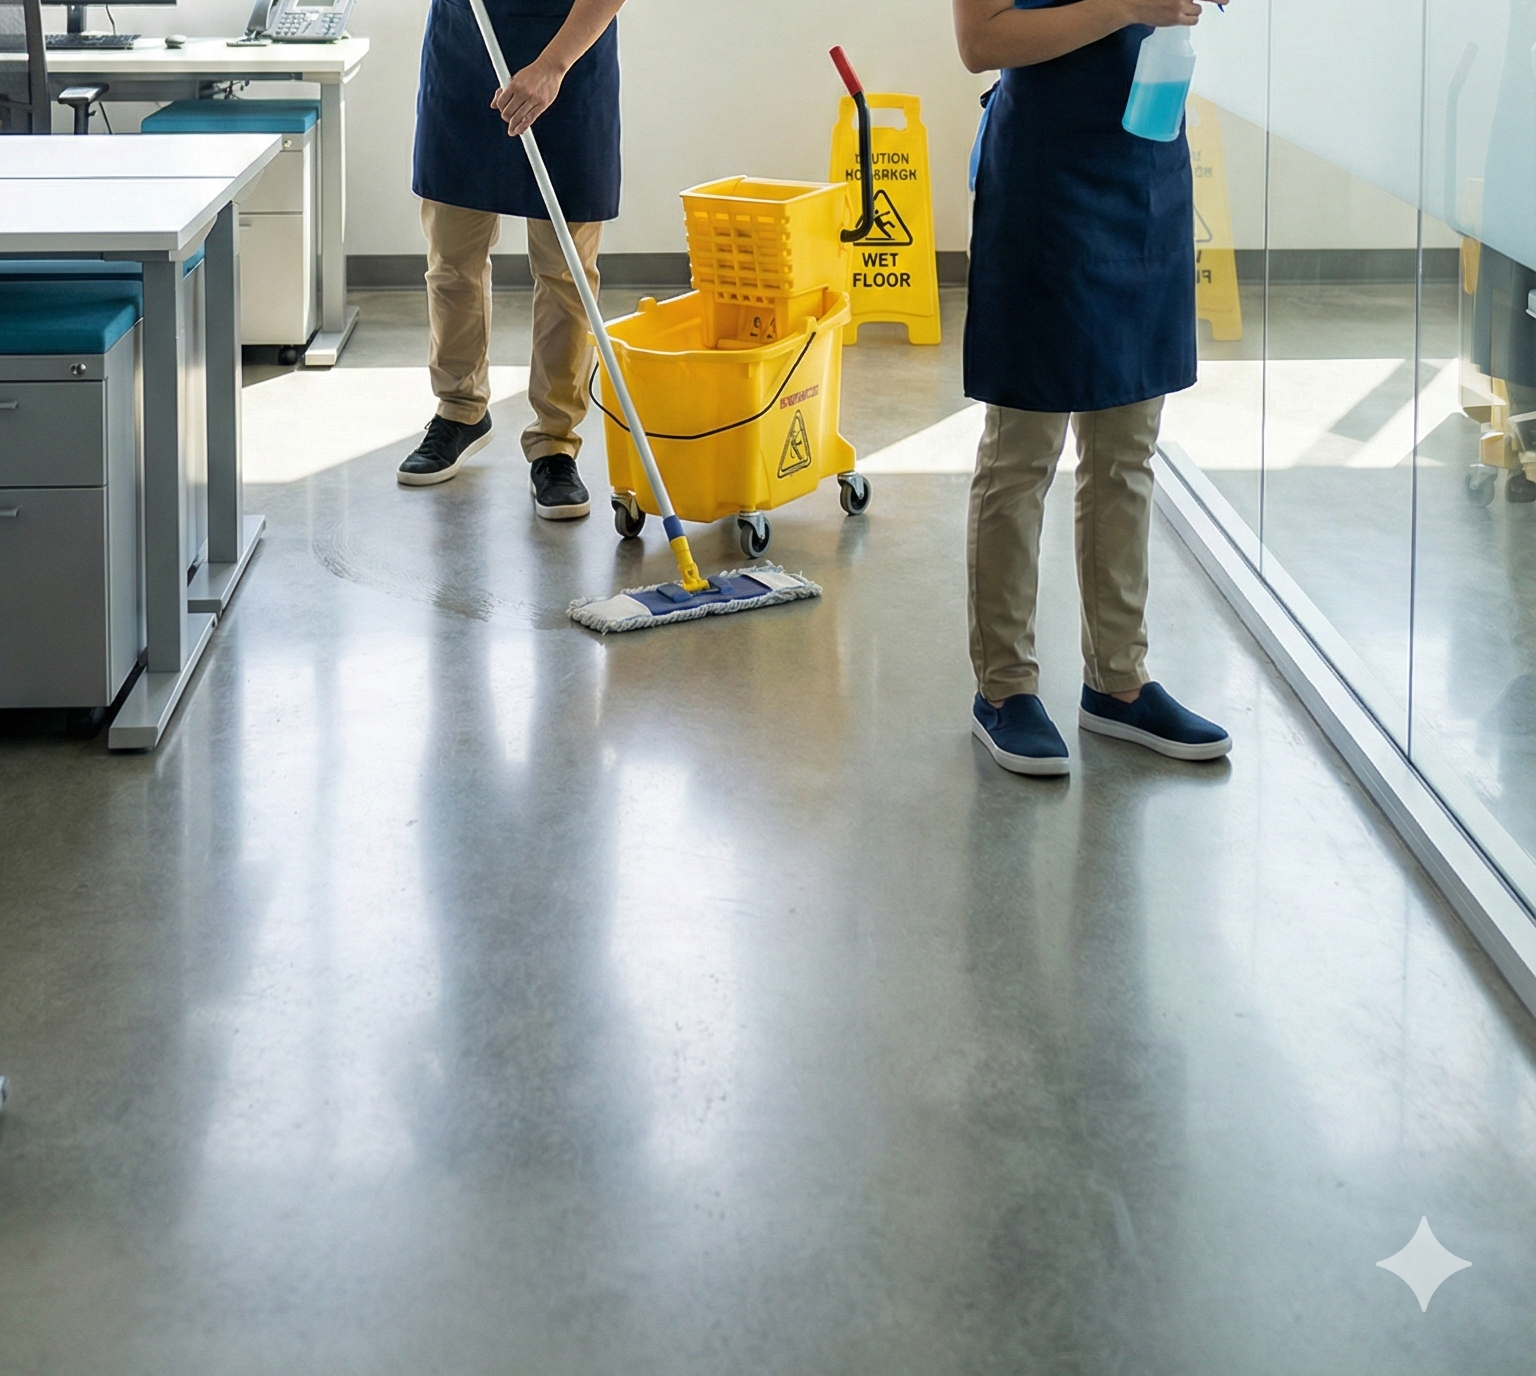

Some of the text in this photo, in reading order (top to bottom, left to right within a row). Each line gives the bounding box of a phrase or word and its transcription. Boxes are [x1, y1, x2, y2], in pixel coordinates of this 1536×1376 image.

[855, 152, 909, 165] UTION
[862, 252, 899, 267] WET
[852, 272, 911, 288] FLOOR
